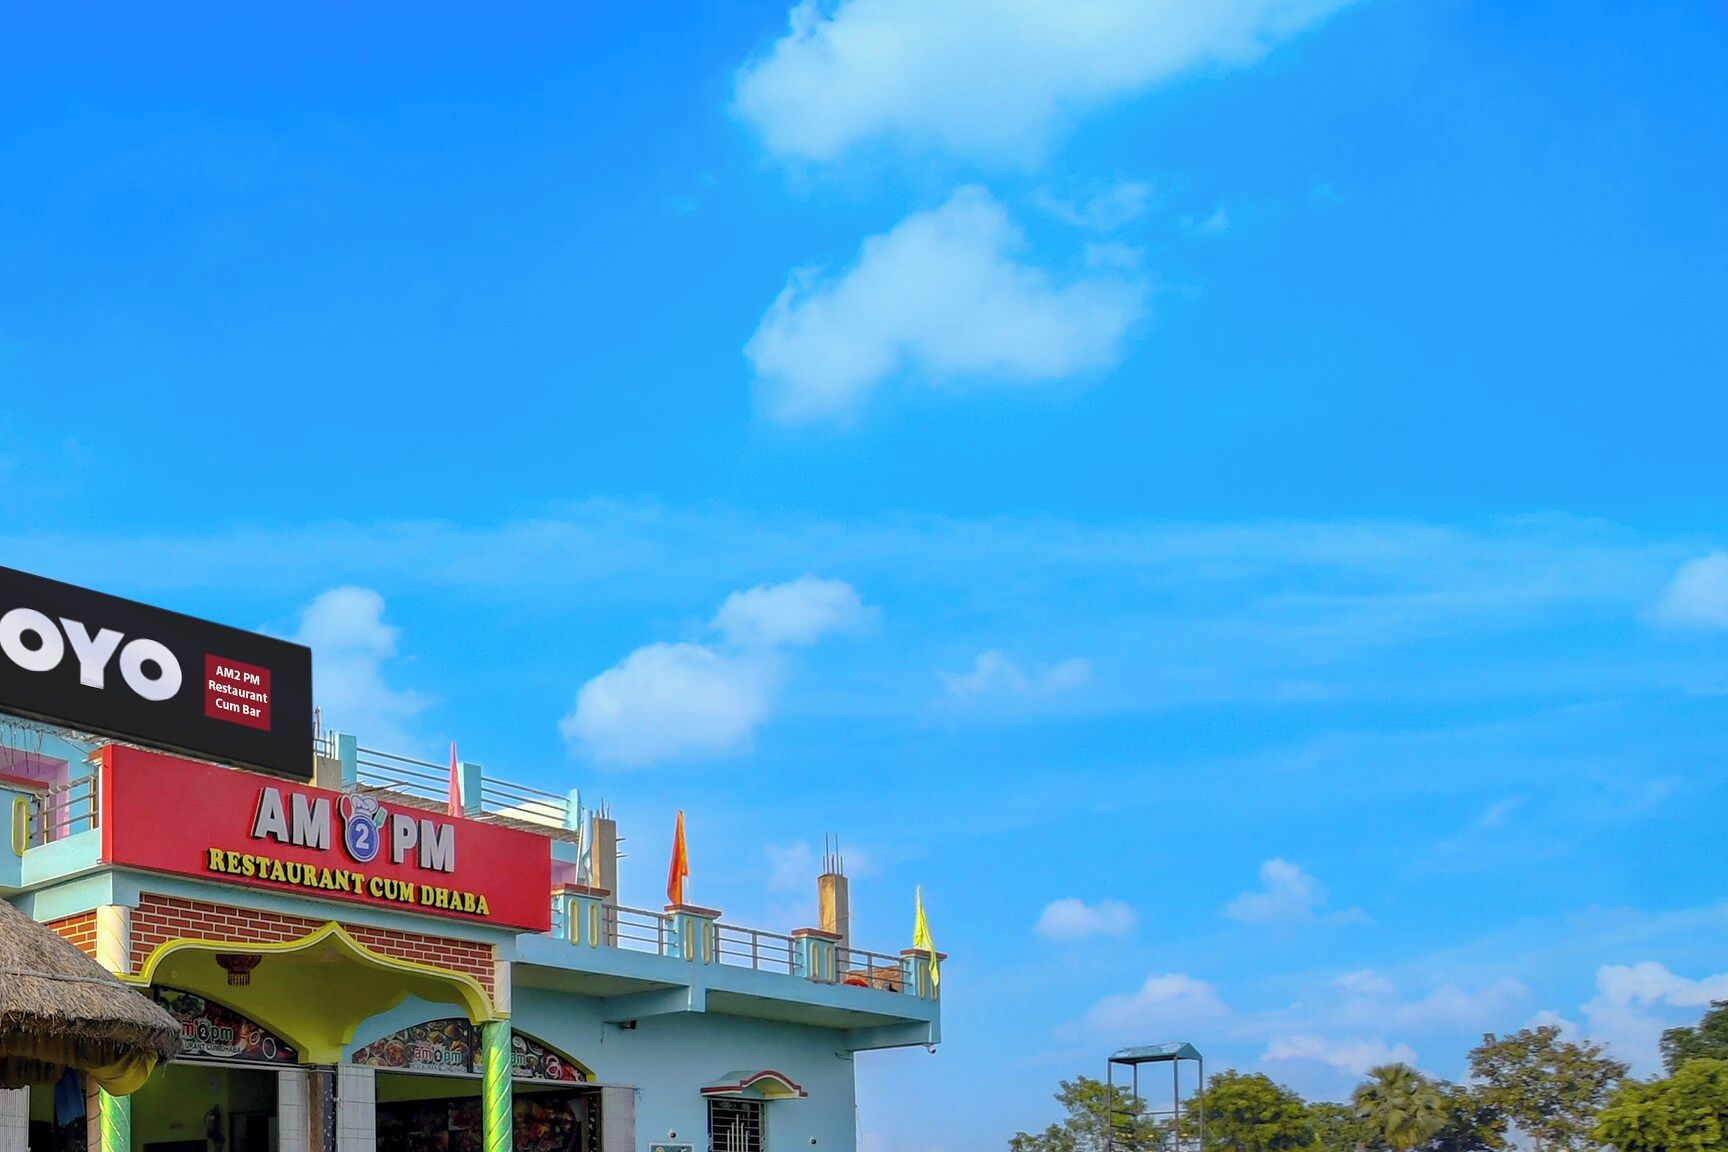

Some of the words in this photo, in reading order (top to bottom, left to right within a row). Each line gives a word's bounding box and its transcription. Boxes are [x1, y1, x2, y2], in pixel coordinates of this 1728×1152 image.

[215, 665, 241, 681] AM2
[243, 671, 260, 686] PM
[208, 679, 268, 704] Restaurant
[215, 698, 240, 713] Cum
[242, 704, 261, 718] Bar
[252, 787, 331, 850] AM
[391, 813, 456, 873] PM
[208, 847, 365, 895] RESTAURANT
[369, 875, 415, 904] CUM
[419, 884, 490, 917] DHABA
